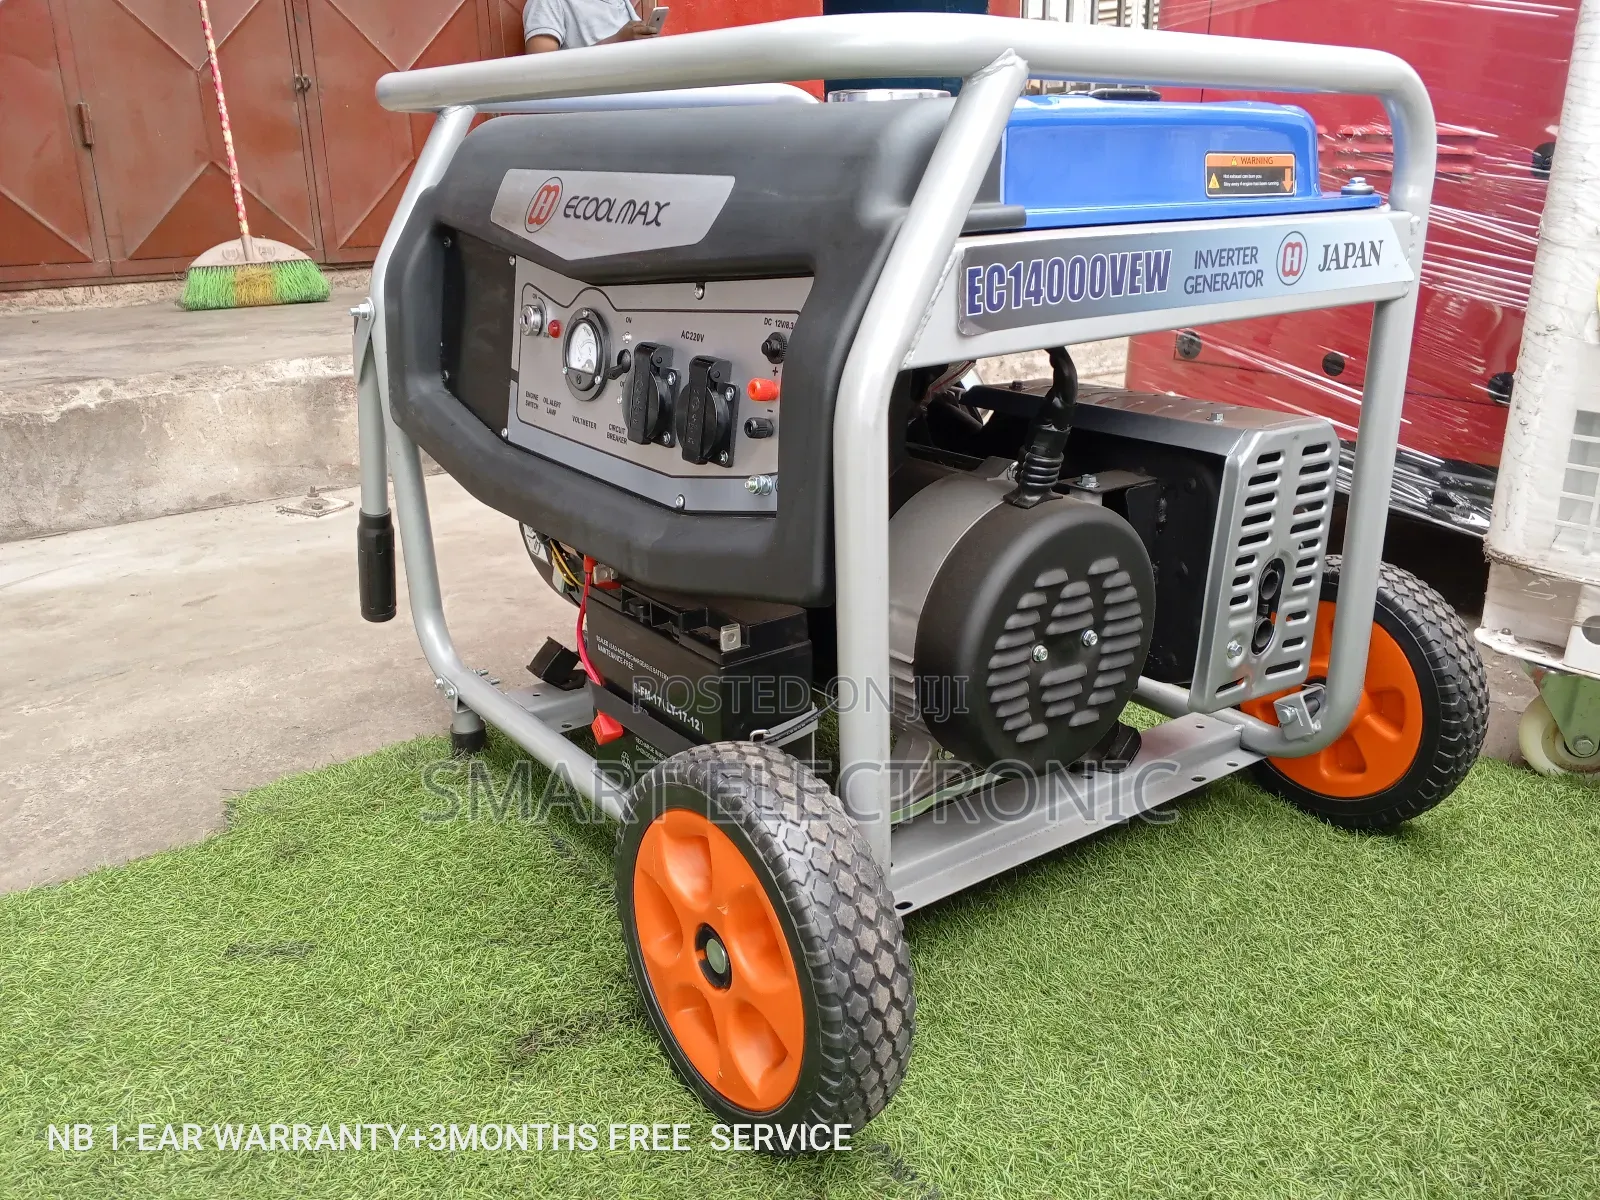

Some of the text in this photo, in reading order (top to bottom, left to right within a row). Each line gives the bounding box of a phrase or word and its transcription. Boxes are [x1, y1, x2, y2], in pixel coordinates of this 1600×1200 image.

[1240, 156, 1274, 165] WARNING
[563, 195, 670, 227] ECOOLMAX
[1194, 247, 1259, 270] INVERTER
[1317, 239, 1385, 272] JAPAN
[965, 249, 1172, 315] EC14000VEW
[1183, 270, 1264, 295] GENERATOR
[763, 317, 773, 326] DC
[681, 330, 705, 343] AC220V
[525, 391, 539, 401] ENGINE
[525, 400, 539, 410] SWITCH
[546, 407, 557, 417] LAMP
[572, 415, 597, 430] VOLTMETER
[608, 423, 626, 435] CIRCUIT
[606, 432, 628, 445] BREAKER
